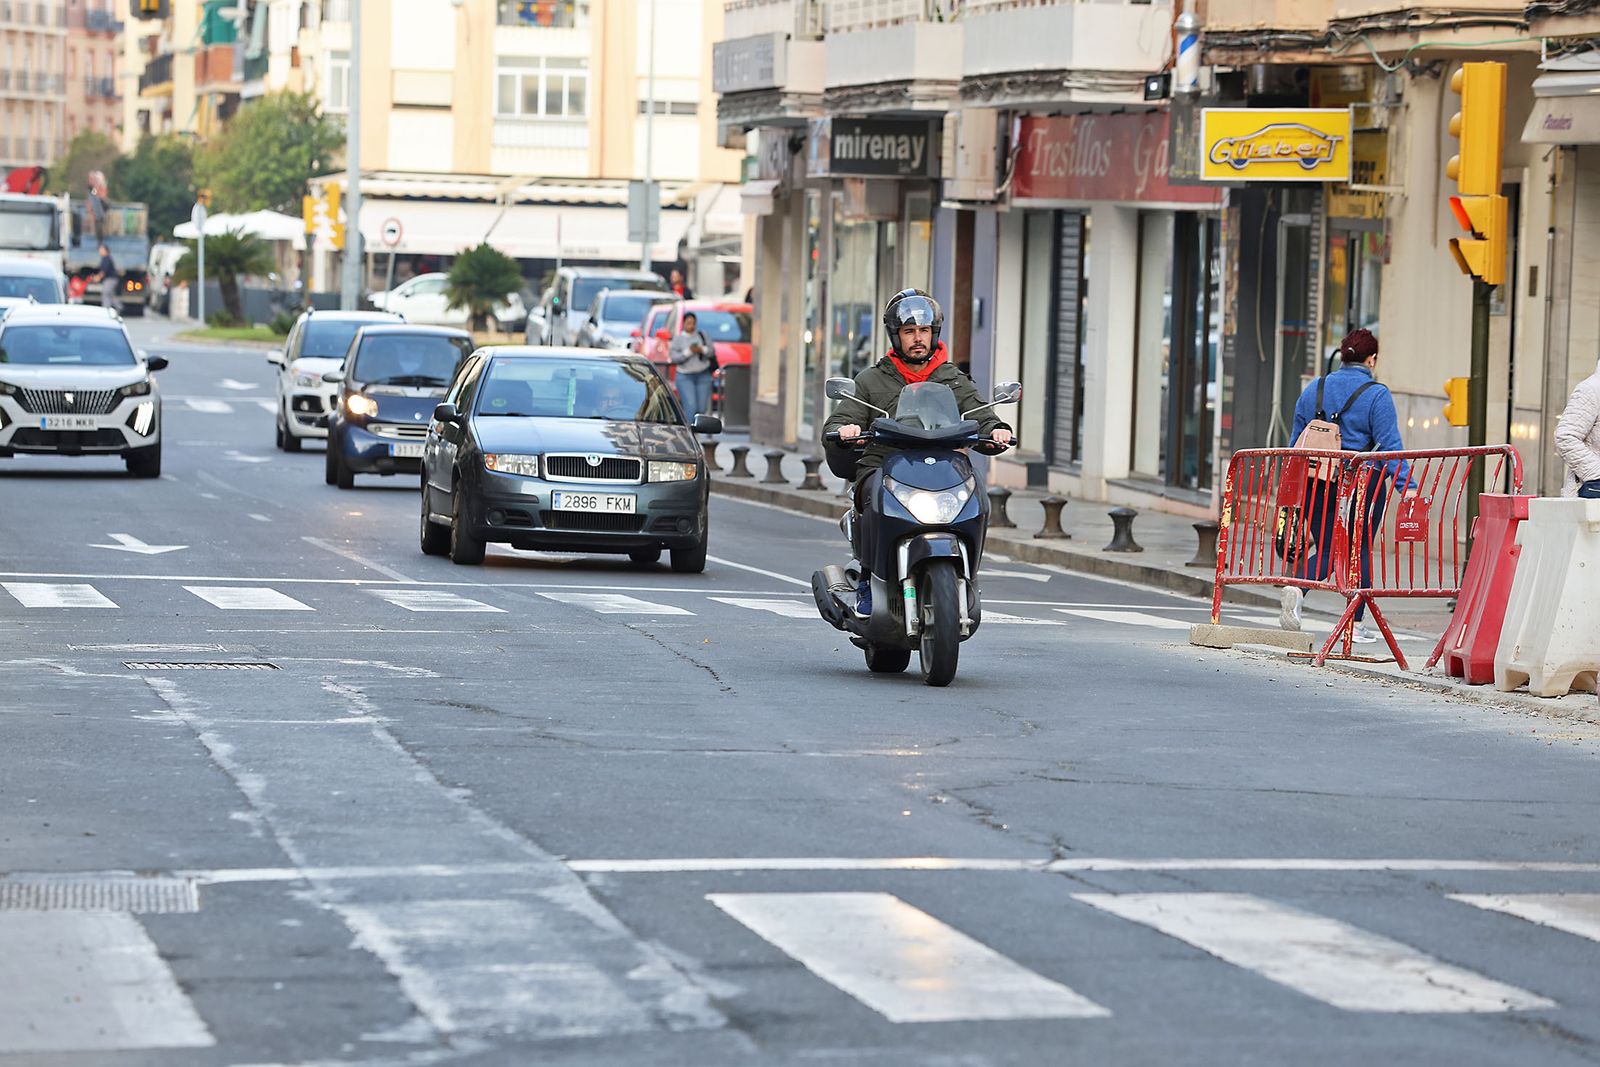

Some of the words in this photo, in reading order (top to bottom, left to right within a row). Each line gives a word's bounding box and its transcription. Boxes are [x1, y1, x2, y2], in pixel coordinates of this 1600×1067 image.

[834, 127, 926, 169] mirenay
[1028, 119, 1112, 176] Tresillos
[1133, 124, 1169, 195] Ga
[564, 495, 597, 509] 2896
[606, 496, 631, 511] FKM
